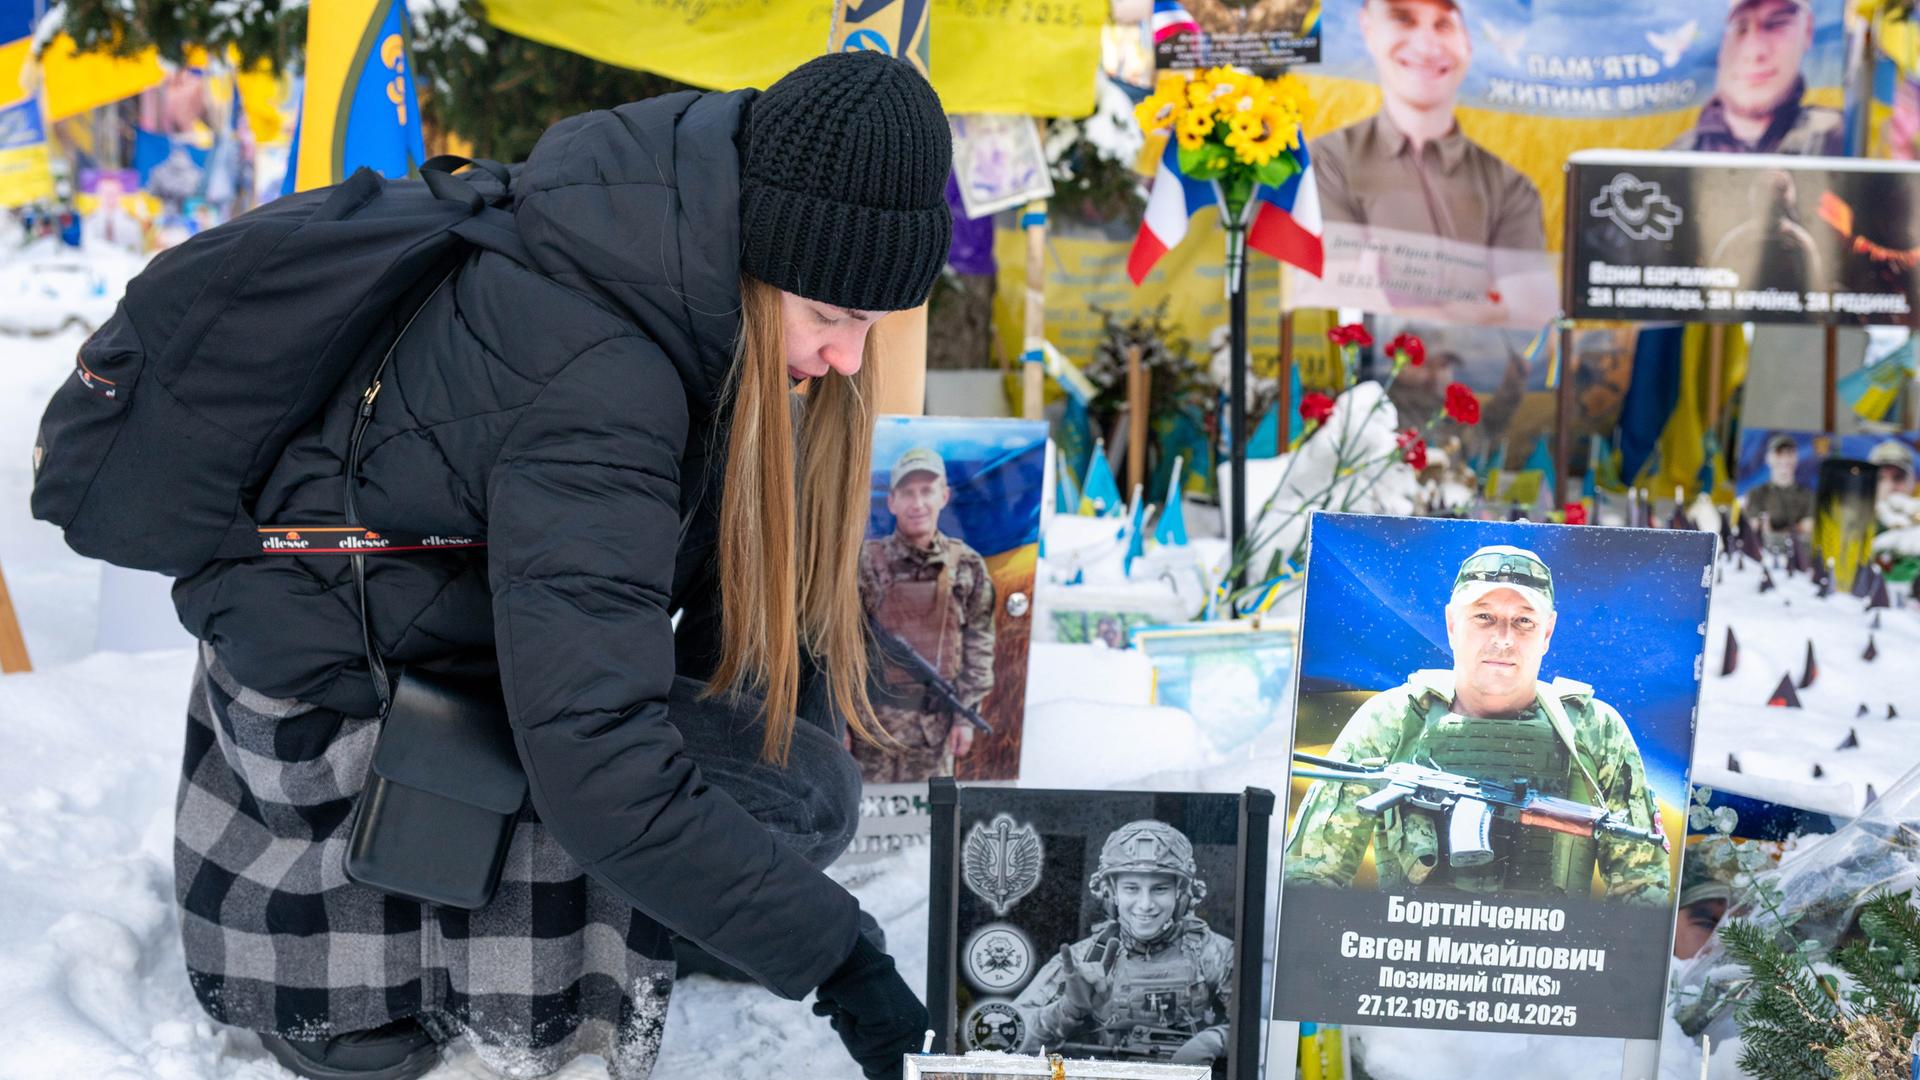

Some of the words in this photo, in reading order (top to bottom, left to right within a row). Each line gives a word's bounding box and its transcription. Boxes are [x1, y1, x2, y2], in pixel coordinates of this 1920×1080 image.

[1486, 77, 1612, 111] ЖИТИМЕ
[262, 536, 309, 549] ellesse
[338, 536, 390, 549] ellesse
[421, 534, 473, 546] ellesse
[1387, 895, 1566, 932] Бортніченко
[1340, 931, 1422, 962] Євген
[1426, 936, 1606, 972] Михайлович
[1378, 966, 1488, 993] Позивний
[1357, 994, 1578, 1027] 27.12.1976-18.04.2025
